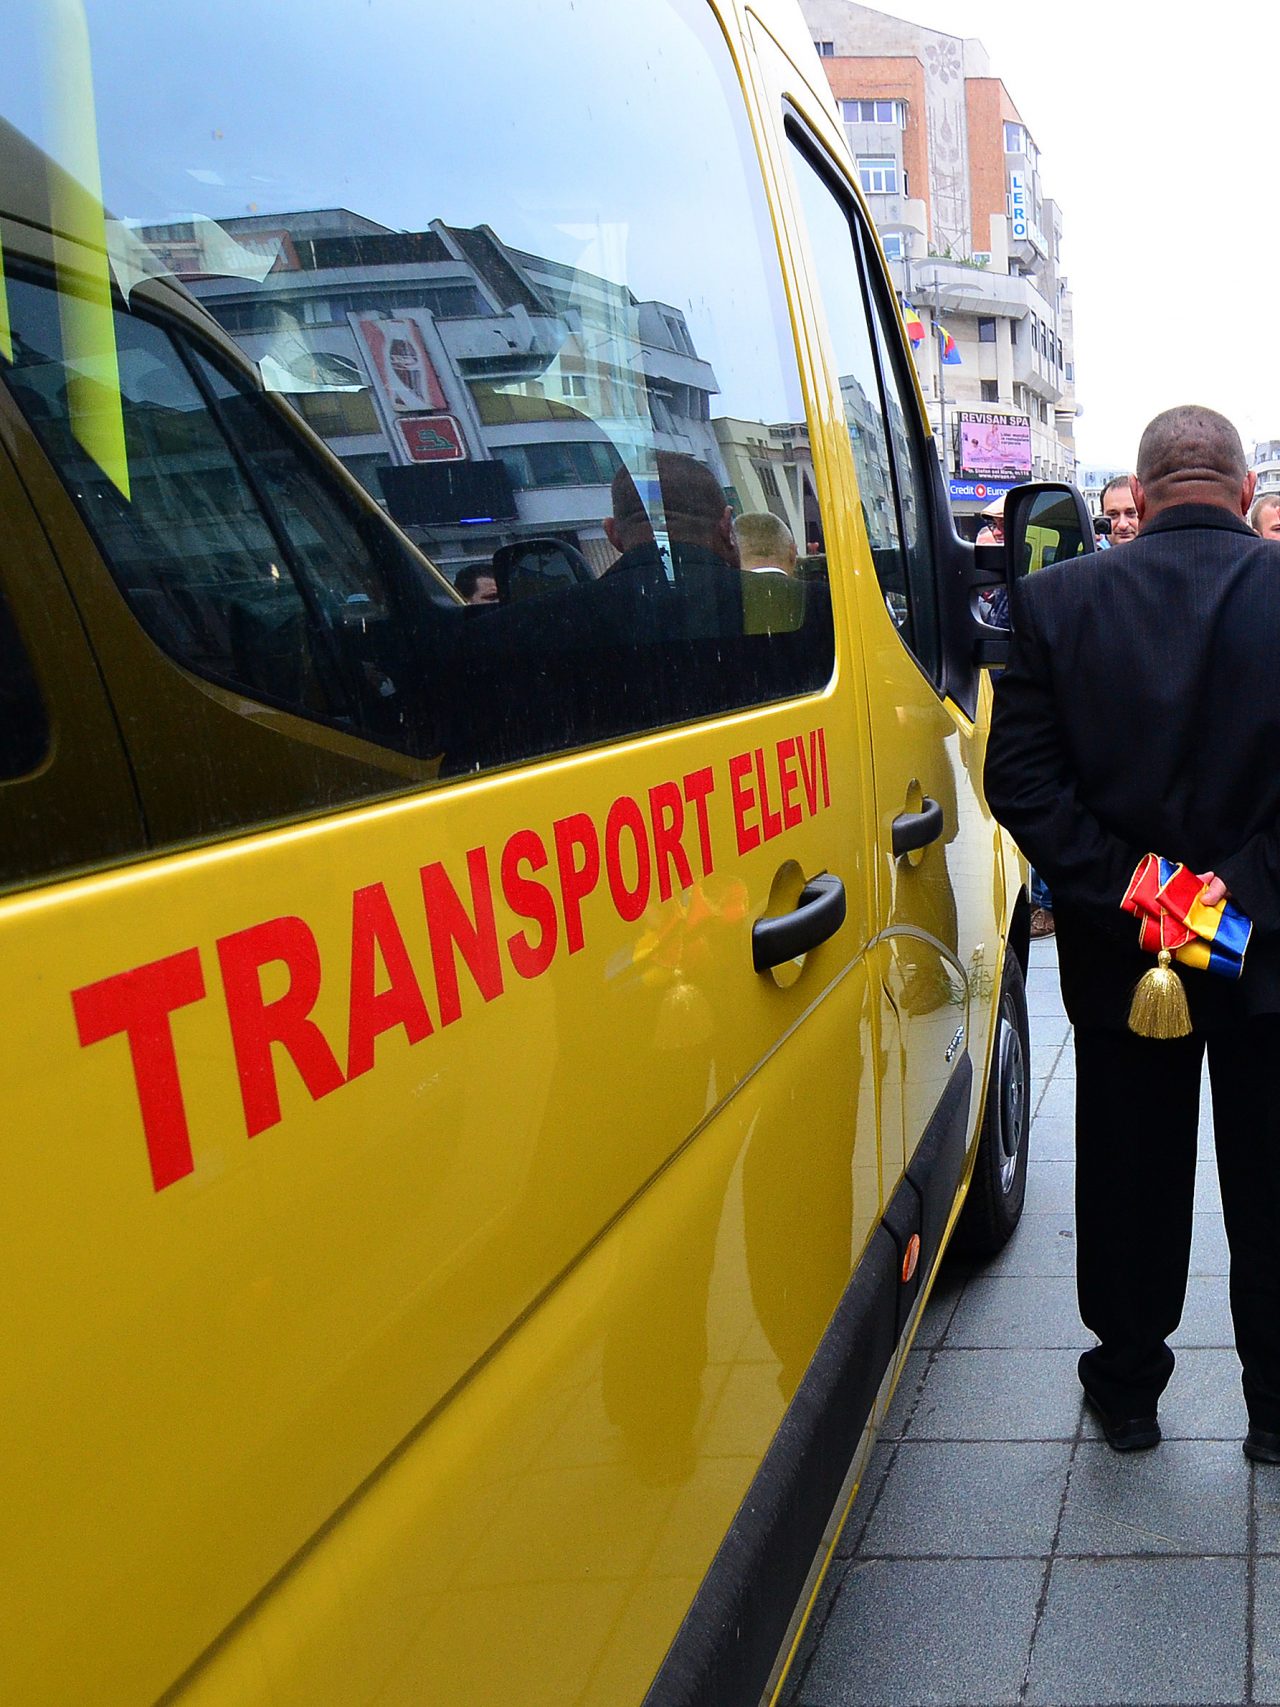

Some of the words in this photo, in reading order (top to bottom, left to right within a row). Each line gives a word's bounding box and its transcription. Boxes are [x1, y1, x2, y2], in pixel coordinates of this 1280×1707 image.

[1012, 176, 1025, 236] LERO
[962, 413, 1007, 425] REVISAN
[1010, 416, 1029, 427] SPA
[950, 485, 975, 495] Credit
[71, 767, 715, 1193] TRANSPORT
[729, 728, 831, 858] ELEVI
